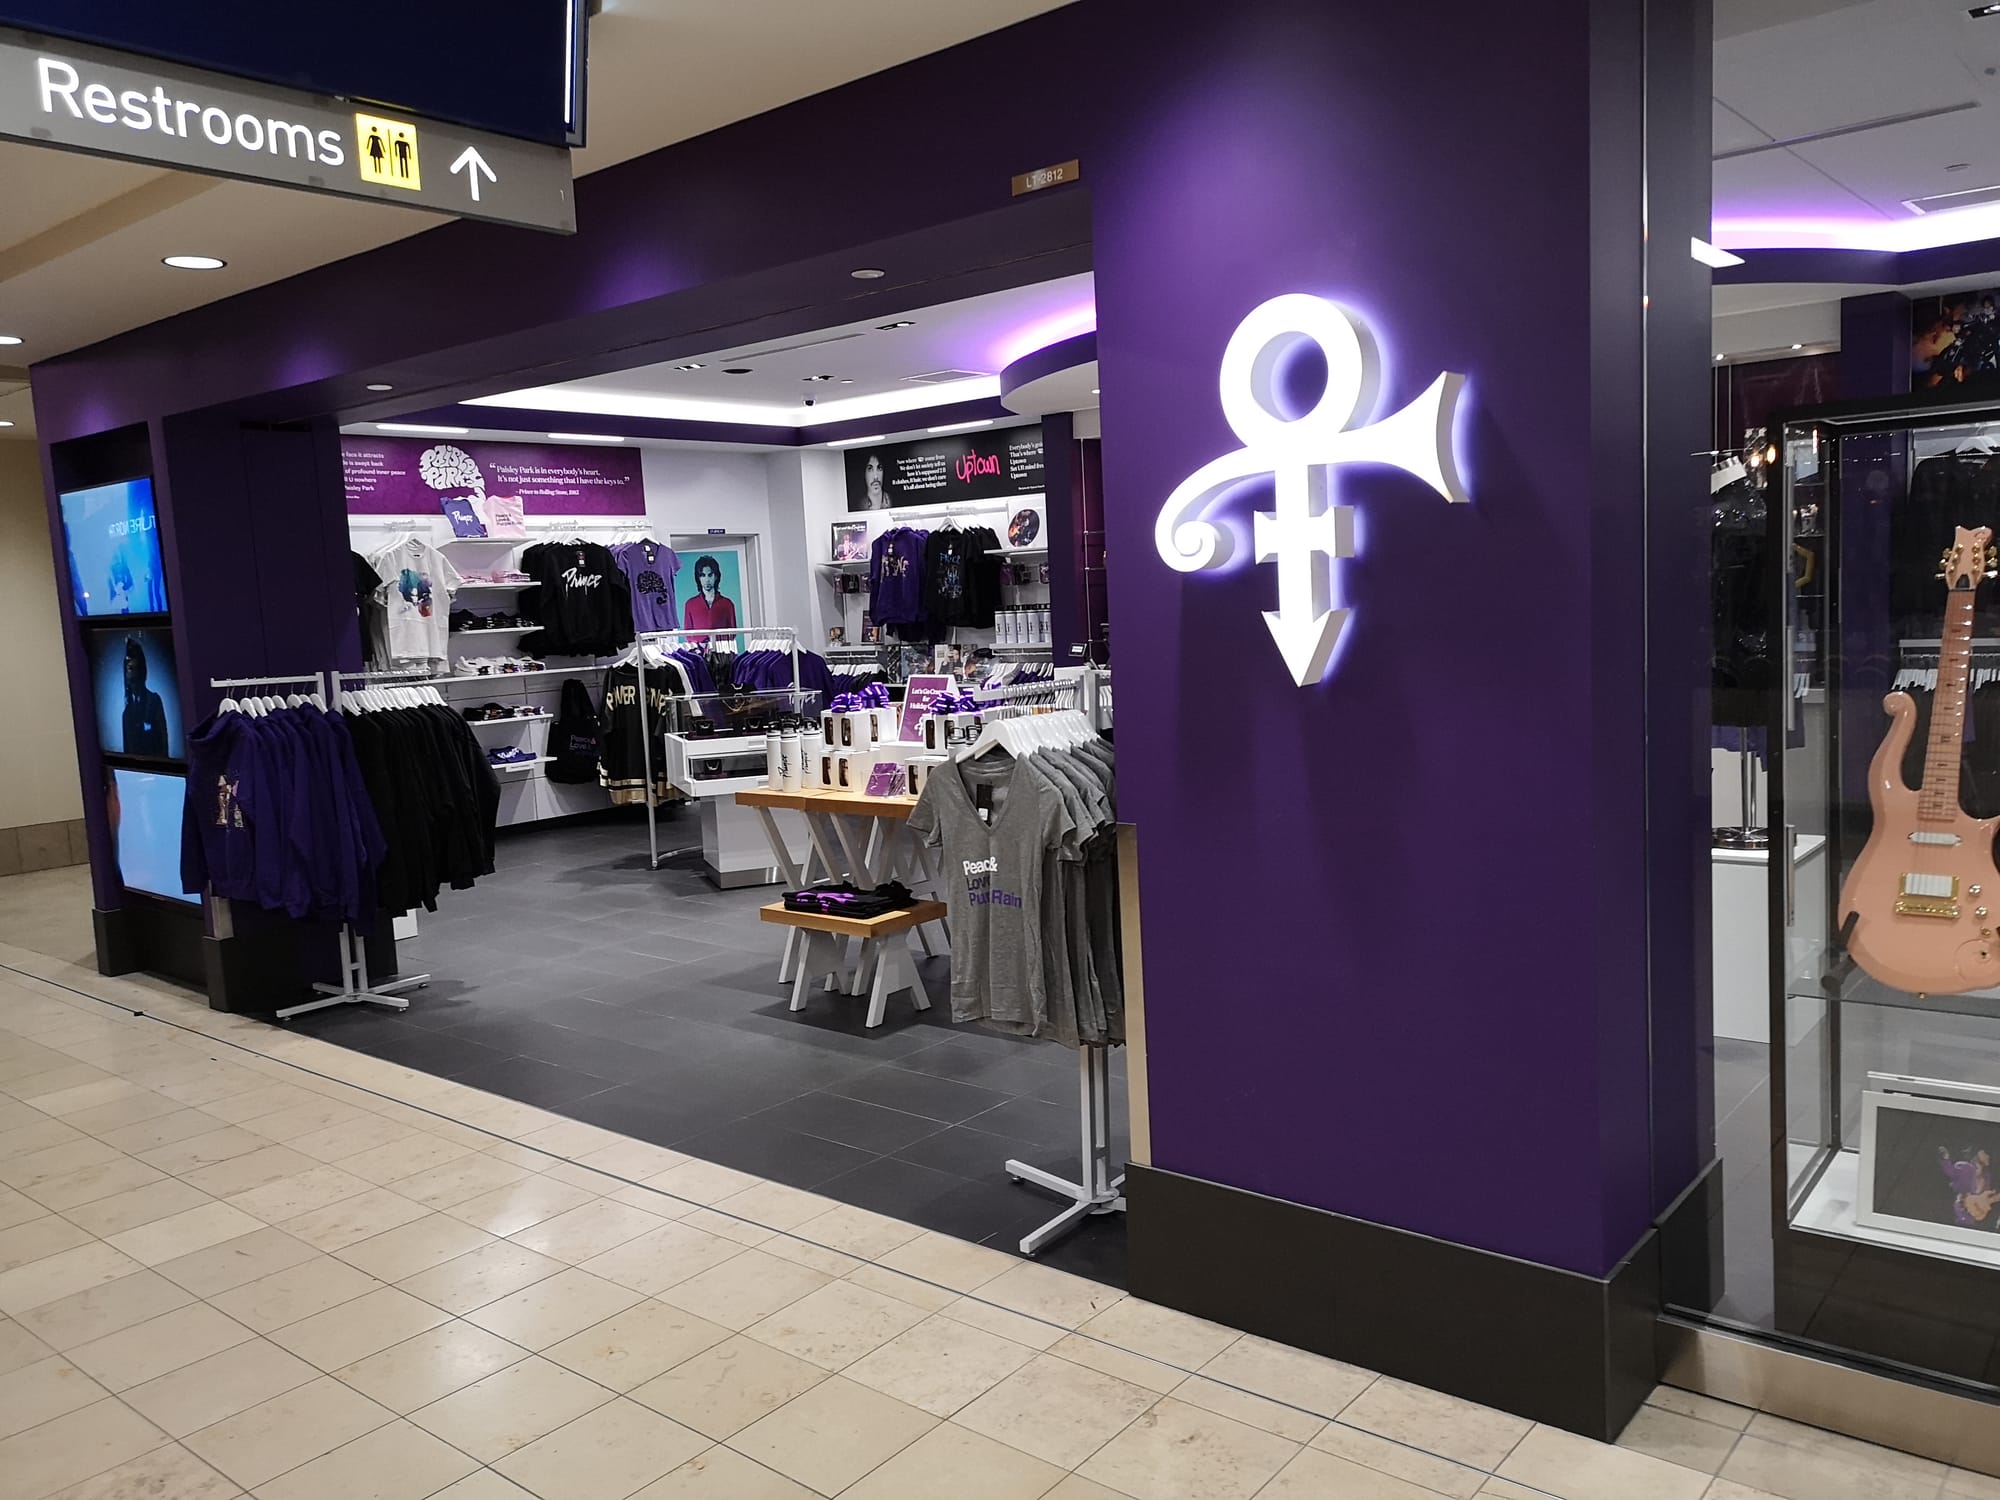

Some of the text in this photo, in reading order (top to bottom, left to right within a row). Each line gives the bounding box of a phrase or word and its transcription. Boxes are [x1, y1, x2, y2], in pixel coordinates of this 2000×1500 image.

[37, 56, 345, 167] Restrooms
[519, 466, 534, 474] Park
[955, 449, 1000, 484] Uptown
[498, 474, 507, 482] It's
[508, 475, 518, 483] not
[518, 475, 530, 485] just
[531, 476, 563, 485] something
[564, 476, 576, 484] that
[580, 476, 593, 485] have
[594, 476, 603, 485] the
[604, 477, 616, 487] keys
[562, 567, 602, 596] Prince
[992, 889, 1023, 909] Rain
